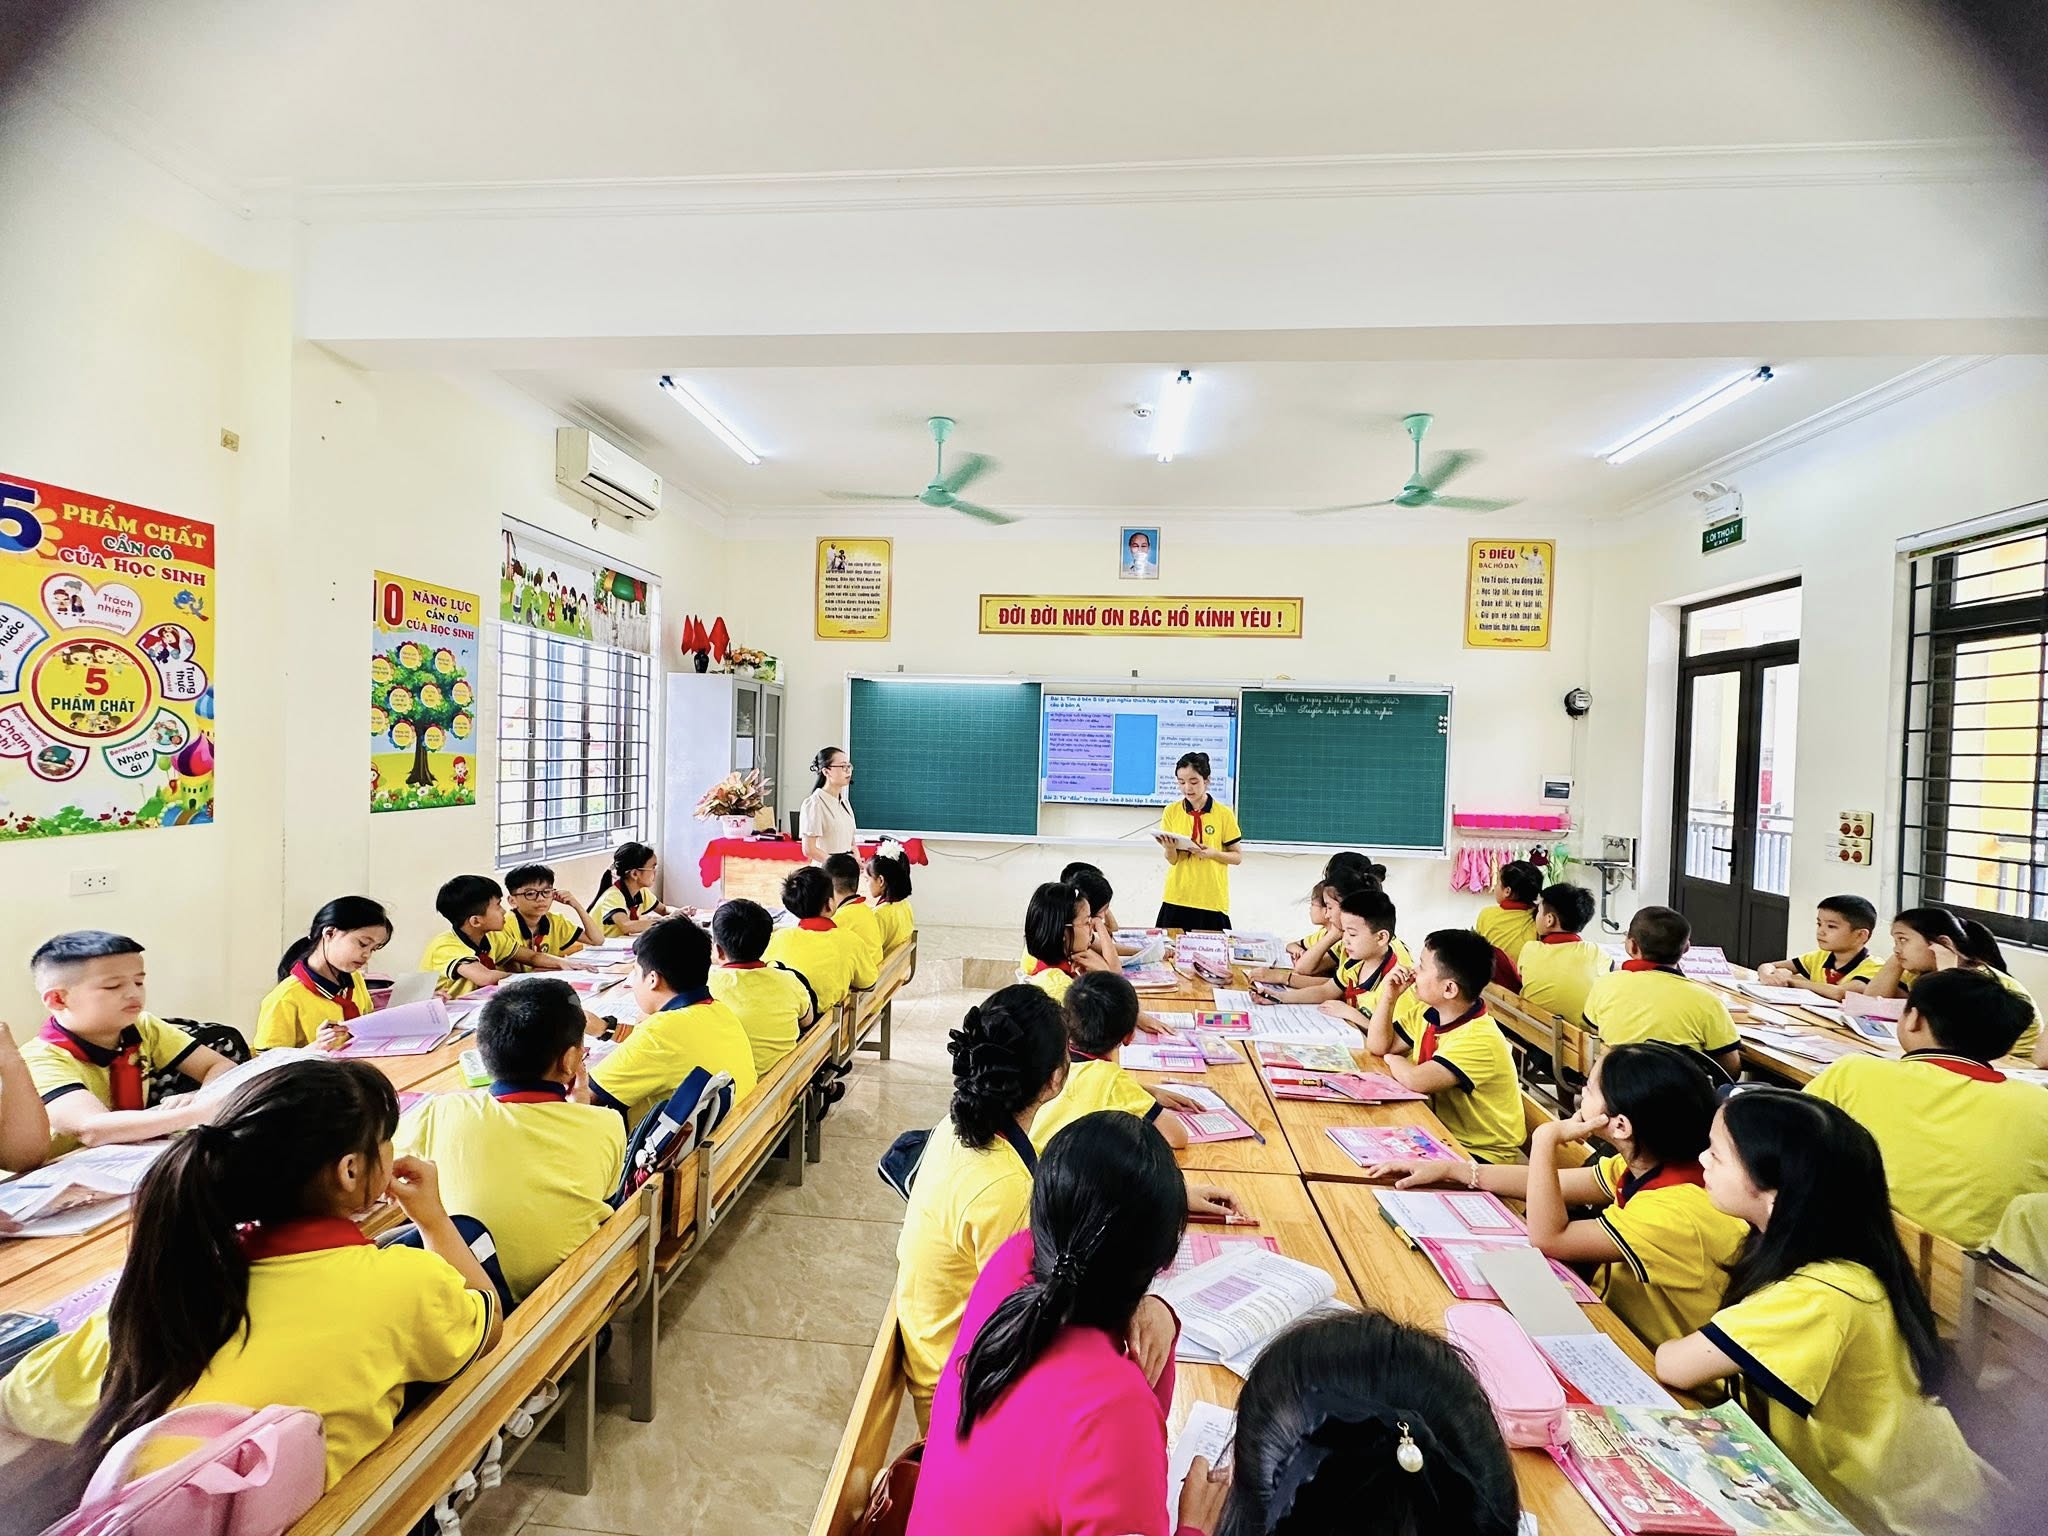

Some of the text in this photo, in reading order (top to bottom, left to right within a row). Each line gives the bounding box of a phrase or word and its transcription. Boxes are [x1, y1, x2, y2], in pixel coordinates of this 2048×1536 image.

[0, 482, 42, 552] 5
[62, 504, 206, 548] PHẨM CHẤT
[103, 533, 172, 560] CẦN CÓ
[1479, 547, 1515, 559] 5 ĐIỀU
[59, 546, 206, 586] CỦA HỌC SINH
[97, 603, 132, 618] nhiệm
[104, 593, 134, 608] Trách
[413, 590, 472, 613] NĂNG LỰC
[426, 608, 459, 623] CẦN CÓ
[999, 604, 1282, 628] ĐỜI ĐỜI NHỚ ƠN BÁC HỒ KÍNH YÊU !
[406, 618, 474, 640] CỦA HỌC SINH
[85, 667, 109, 695] 5
[176, 671, 185, 693] thực
[186, 667, 195, 694] Trung
[52, 693, 135, 712] PHẨM CHẤT
[0, 719, 30, 750] Chăm
[118, 750, 149, 766] Nhân
[131, 762, 142, 773] ái
